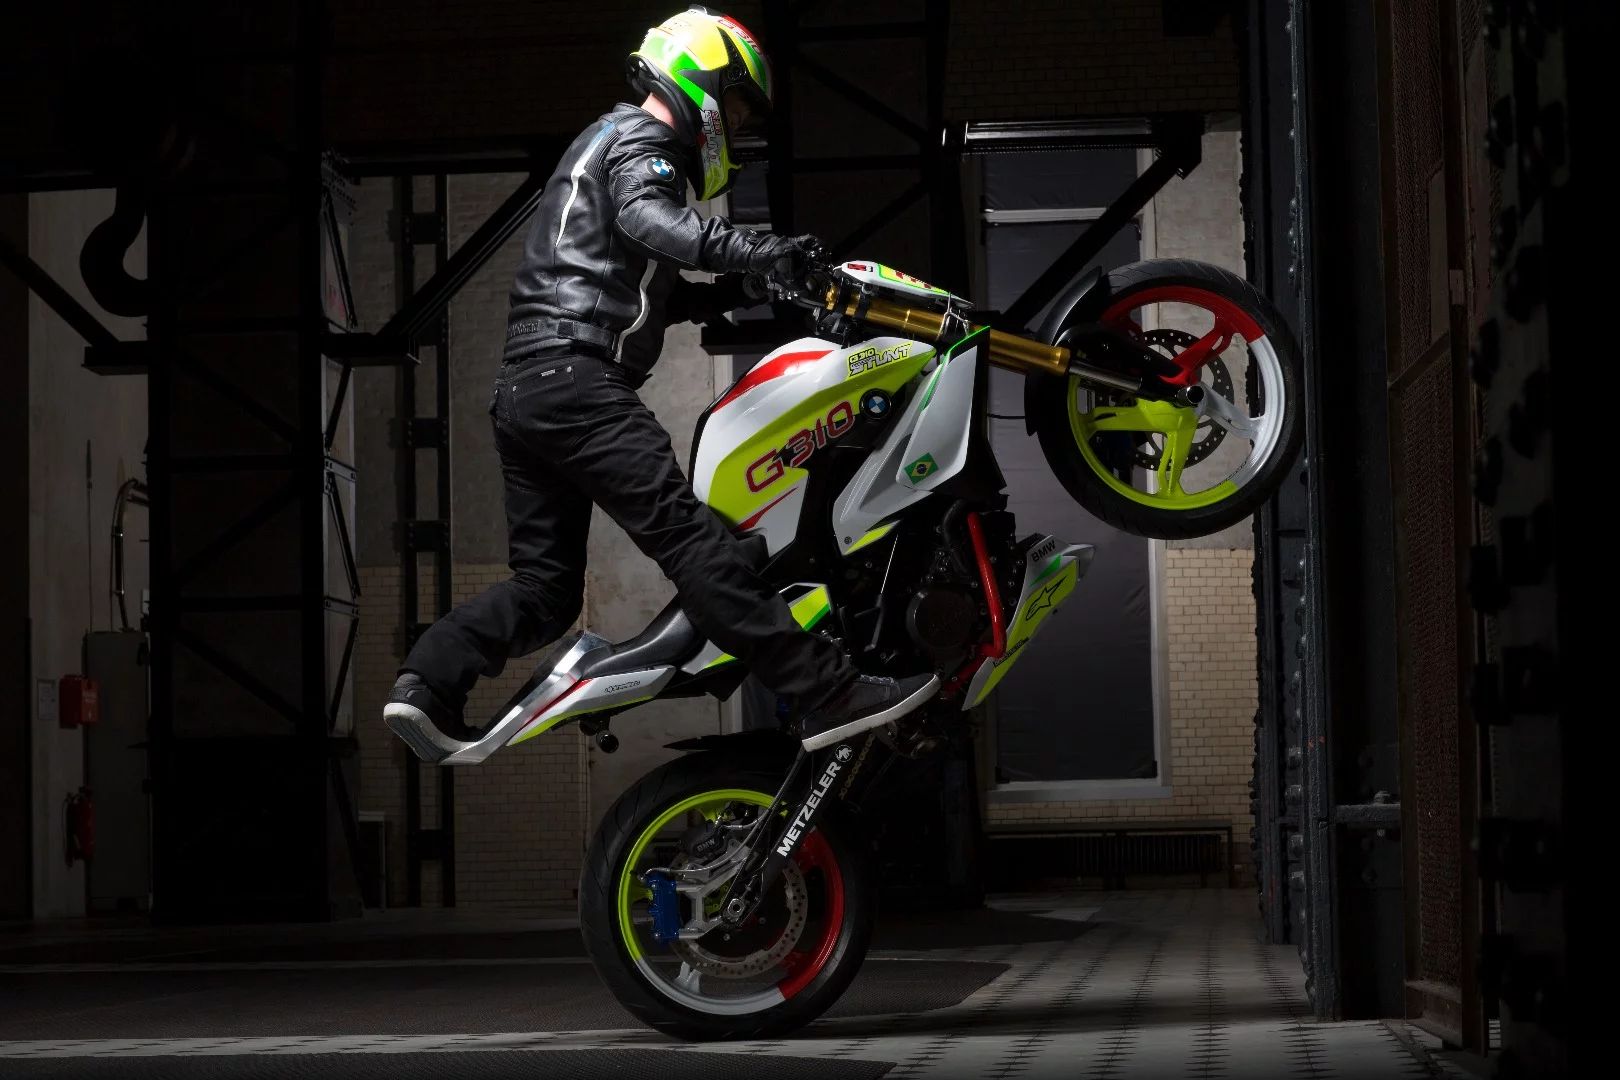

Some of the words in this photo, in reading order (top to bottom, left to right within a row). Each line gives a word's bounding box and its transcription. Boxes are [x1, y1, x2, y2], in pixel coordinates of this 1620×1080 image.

[849, 343, 912, 377] STUNT
[1031, 539, 1057, 563] BMW
[776, 761, 842, 857] METZELER
[696, 838, 716, 852] BMW
